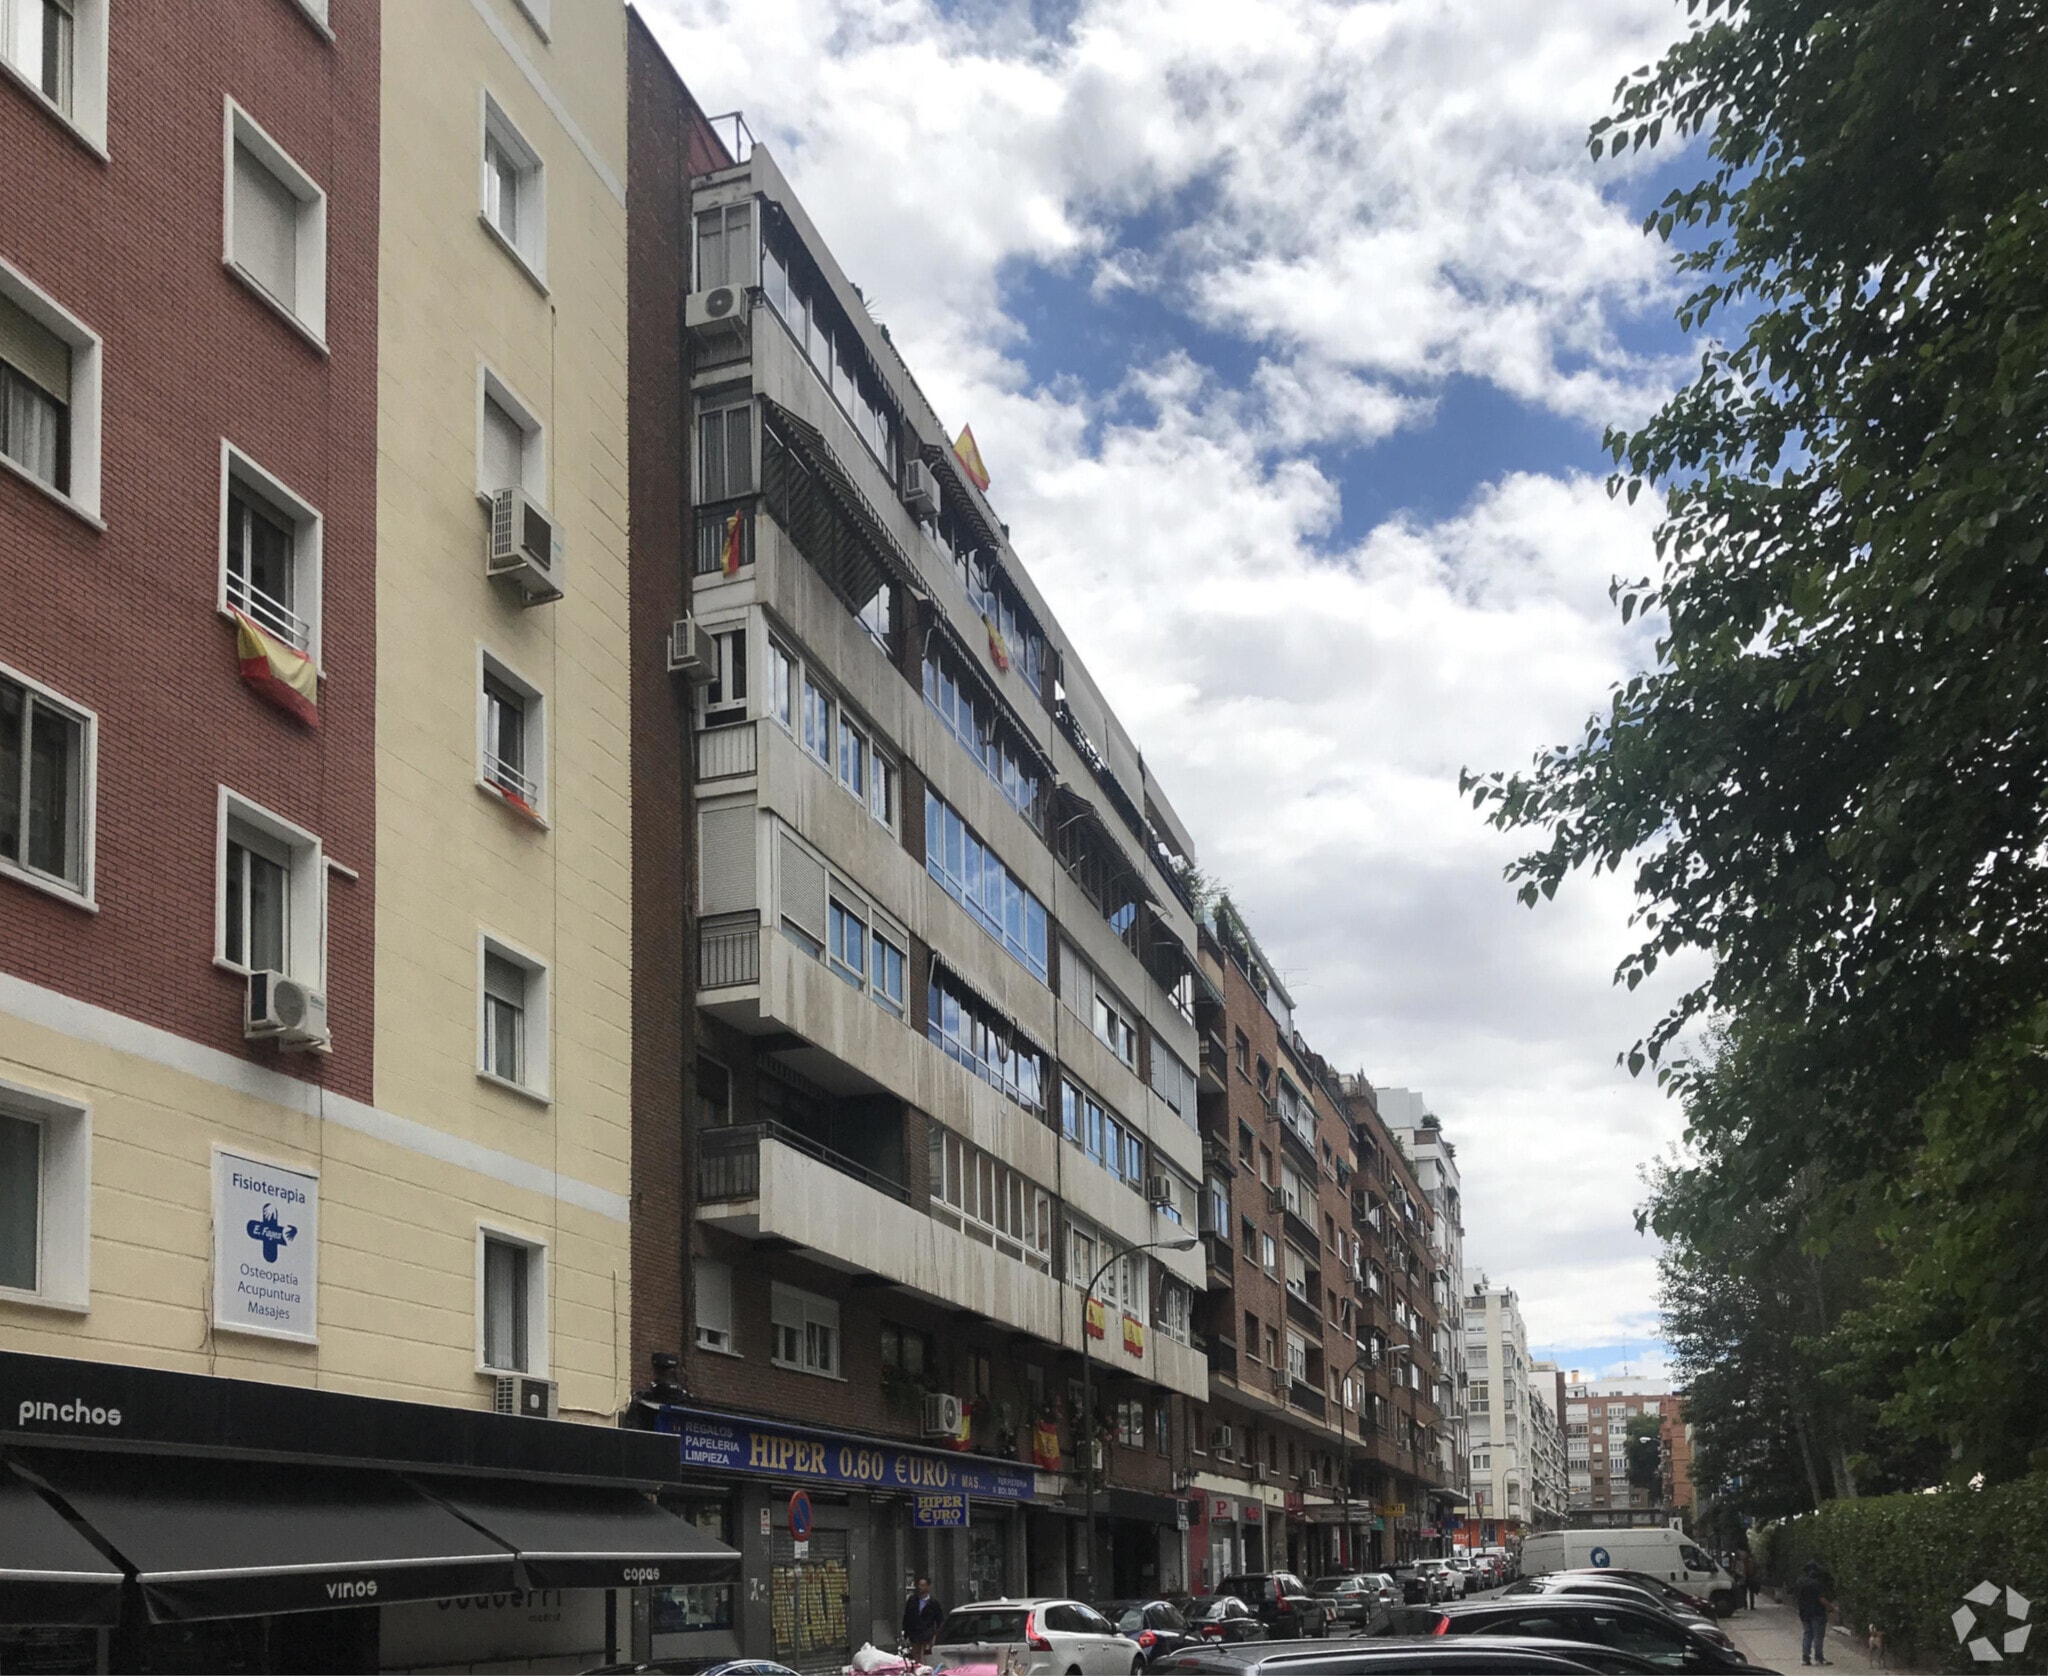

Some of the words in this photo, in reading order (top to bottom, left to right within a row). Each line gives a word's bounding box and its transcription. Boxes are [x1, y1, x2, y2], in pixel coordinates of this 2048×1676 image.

[232, 1172, 306, 1204] Fisioterapia
[239, 1263, 298, 1286] Osteopatía
[237, 1280, 301, 1304] Acupuntura
[247, 1302, 290, 1320] Masajes
[19, 1398, 122, 1426] pinchos
[685, 1421, 734, 1438] REGALOS
[685, 1435, 740, 1453] PAPELERIA
[685, 1449, 730, 1465] LIMPIEZA
[749, 1432, 827, 1474] HIPER
[838, 1447, 884, 1481] 0.60
[917, 1495, 964, 1509] HIPER
[623, 1567, 660, 1586] copas
[326, 1580, 378, 1600] vinos
